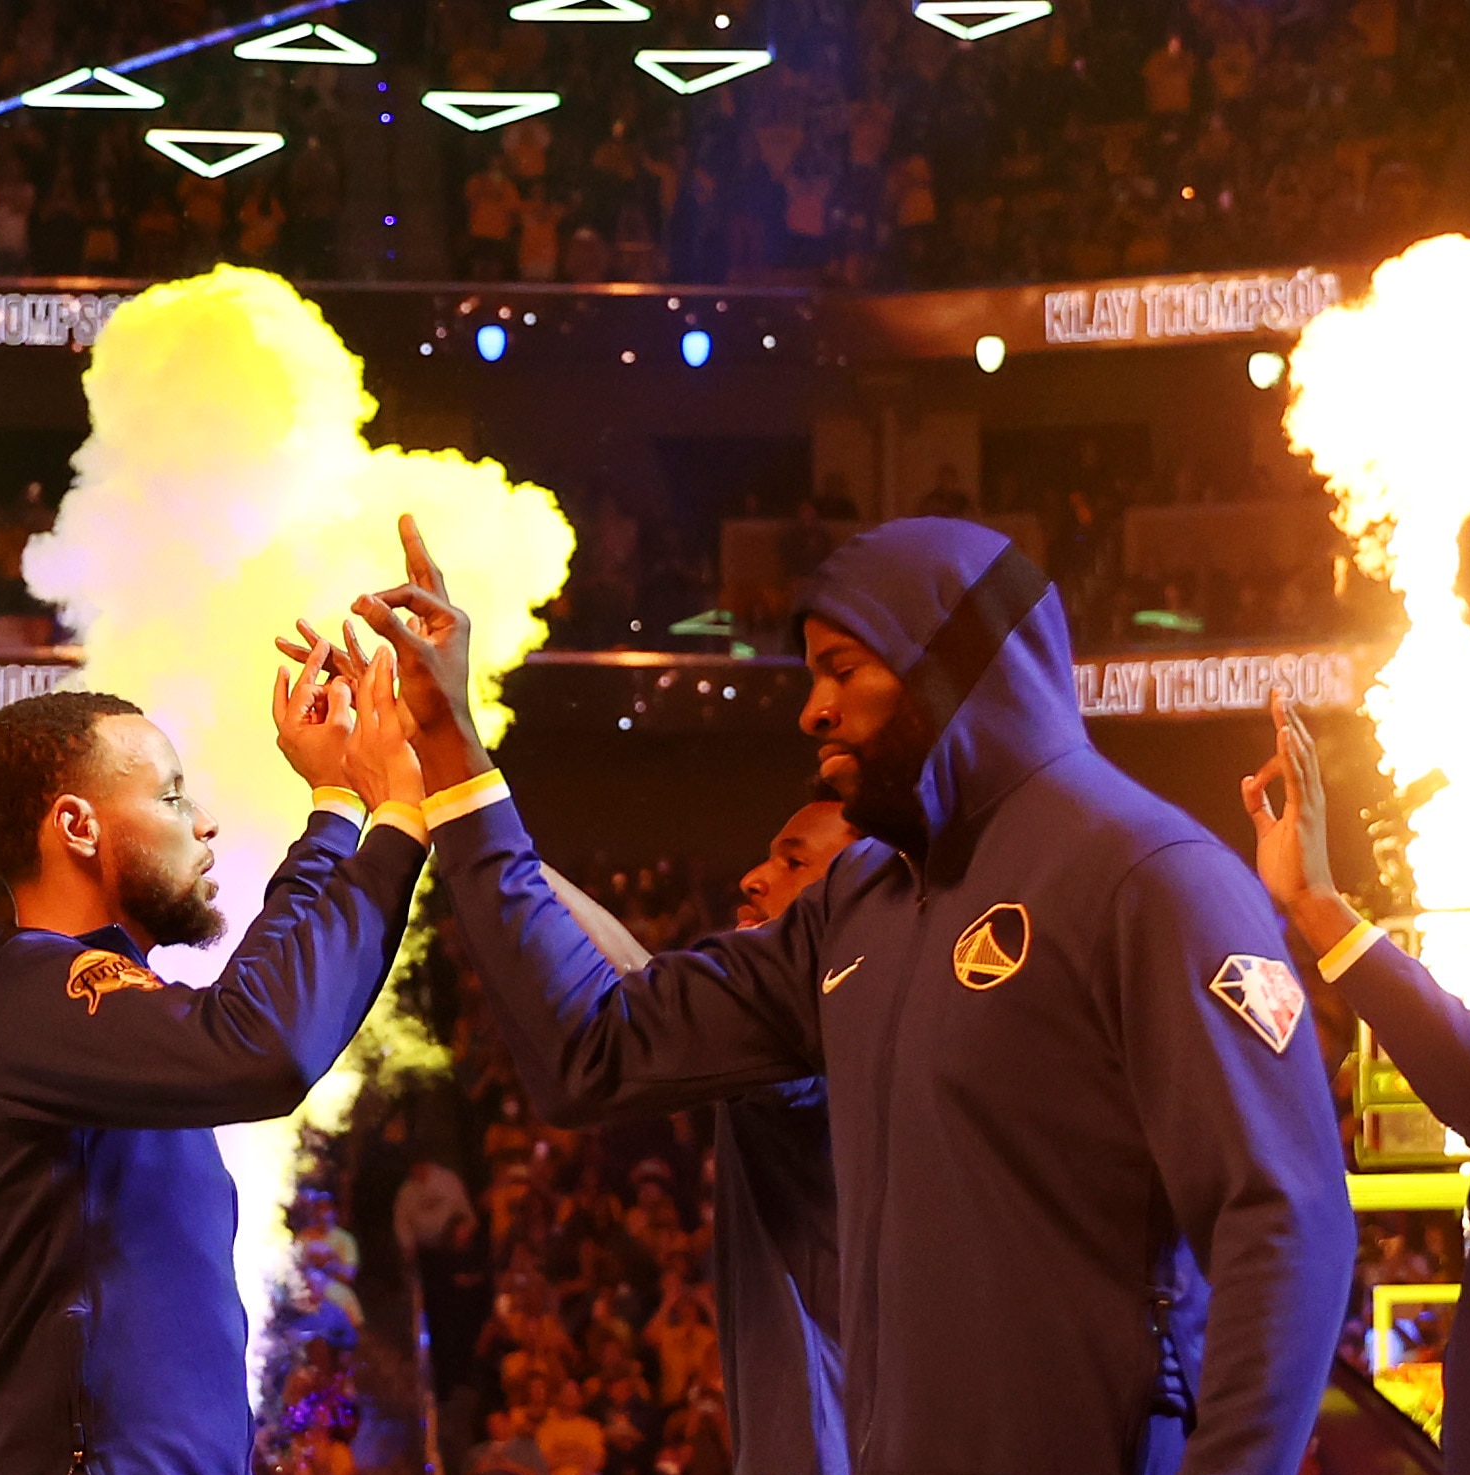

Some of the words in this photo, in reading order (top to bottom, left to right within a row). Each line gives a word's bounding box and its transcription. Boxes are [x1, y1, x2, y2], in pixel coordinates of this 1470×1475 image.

[1044, 287, 1139, 343] KLAY
[1072, 661, 1149, 717] LAY
[1151, 653, 1355, 713] THOMPSON
